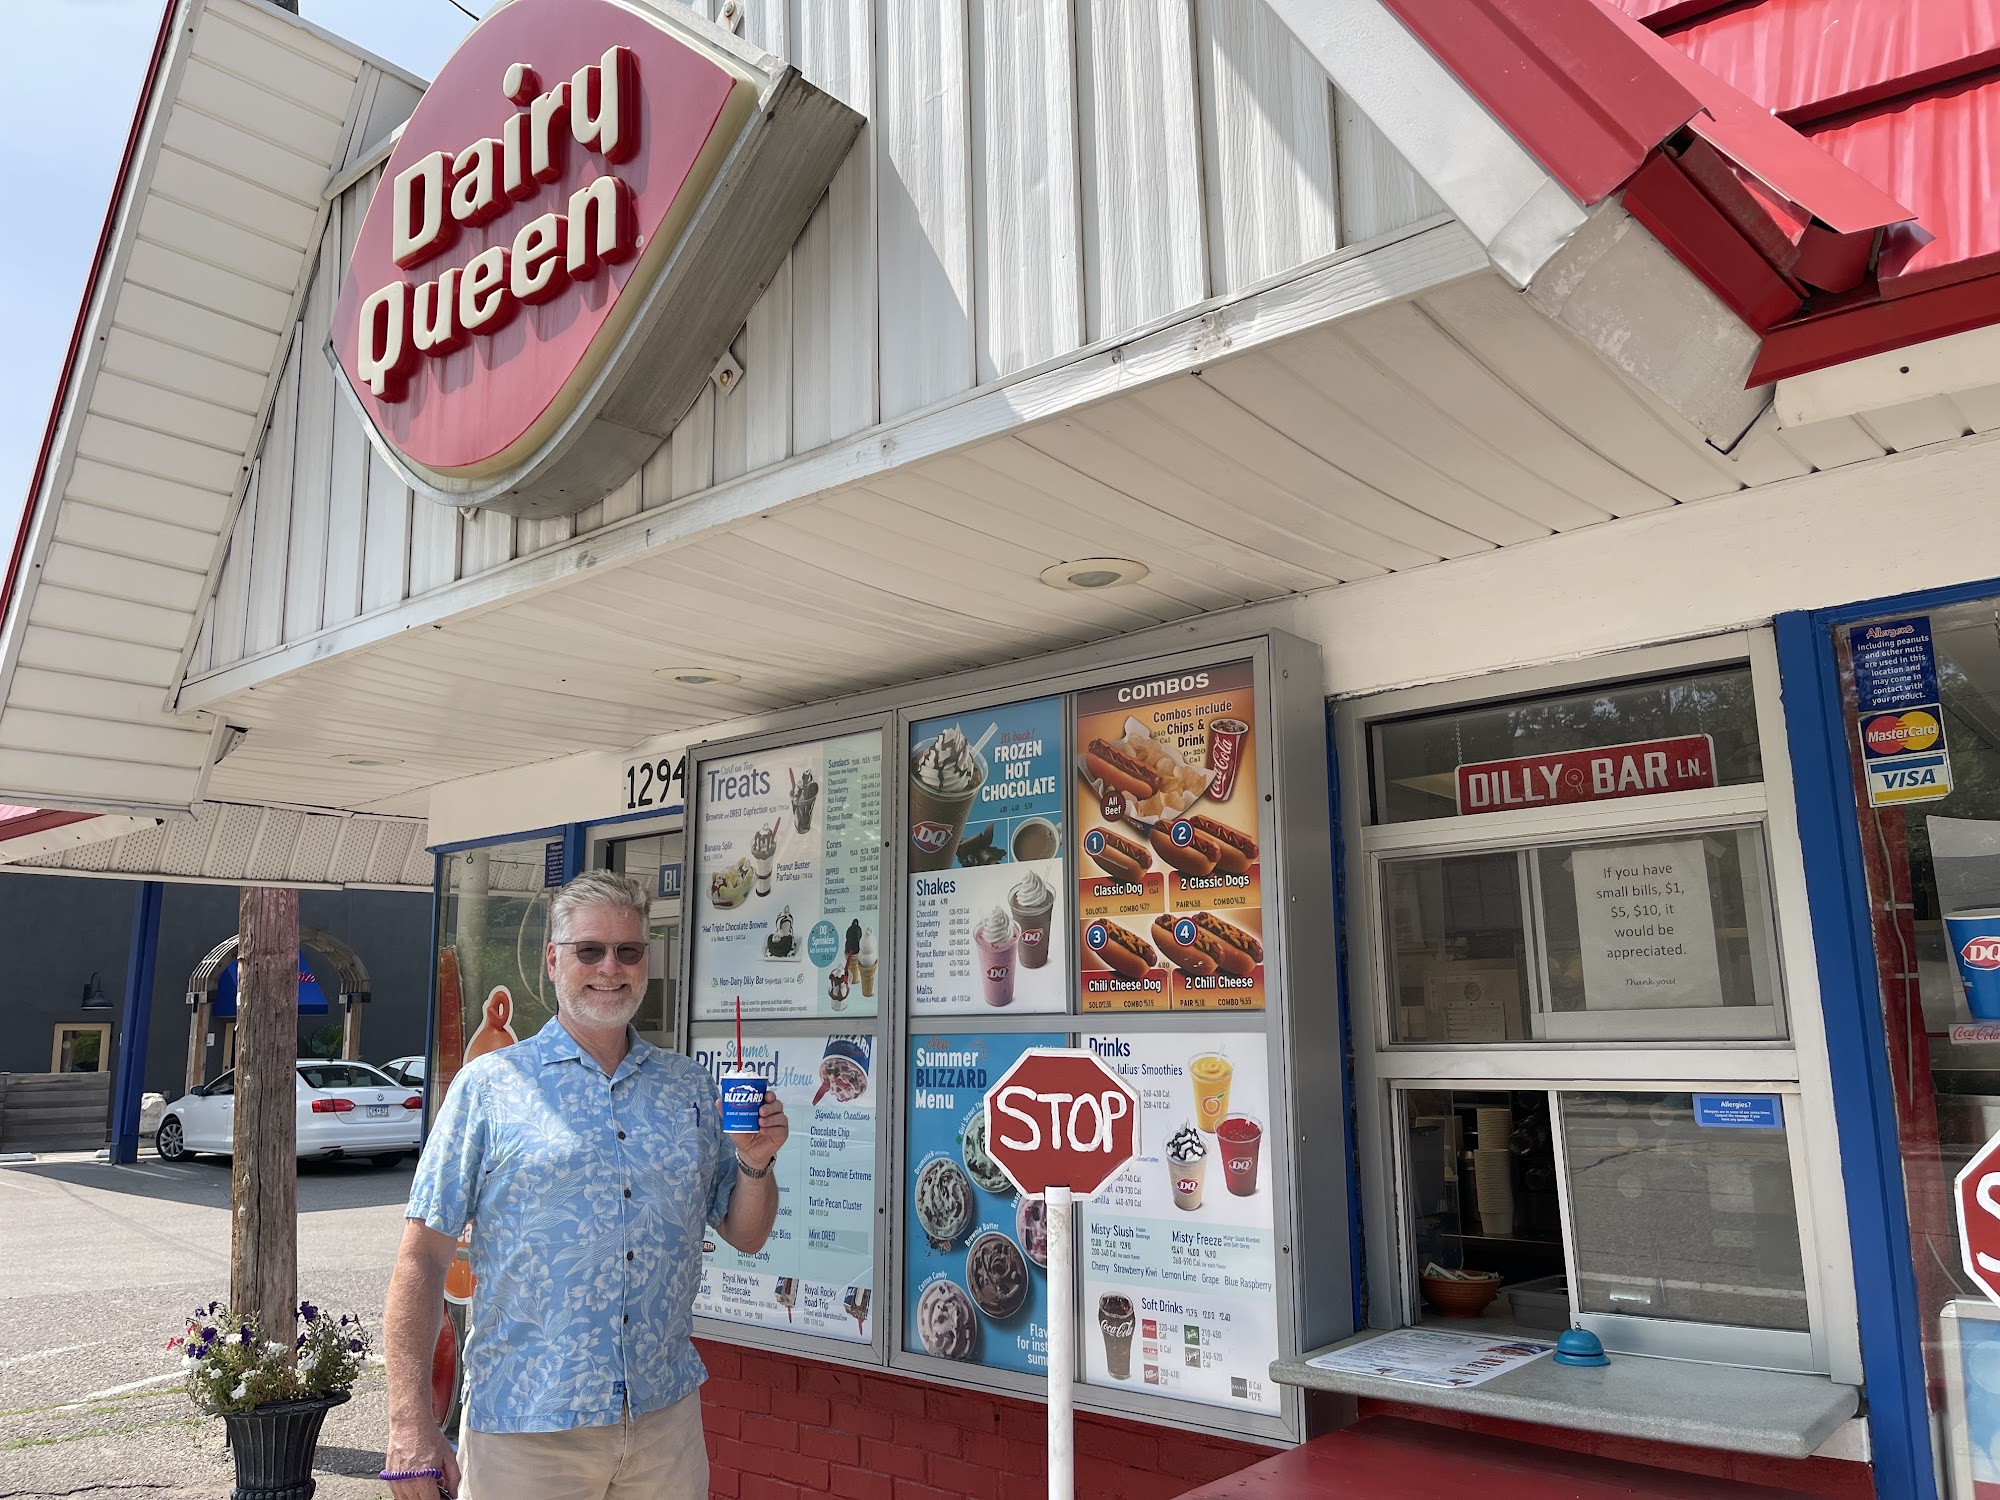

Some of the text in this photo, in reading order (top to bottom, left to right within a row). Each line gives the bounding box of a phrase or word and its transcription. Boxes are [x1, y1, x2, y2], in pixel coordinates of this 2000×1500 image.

[393, 45, 632, 268] Dairy
[358, 176, 632, 401] Queen
[1866, 625, 1914, 639] Allergens
[1857, 635, 1929, 651] including peanuts
[1865, 645, 1923, 659] and other nuts
[1879, 657, 1898, 667] used
[1871, 663, 1921, 676] location and
[1117, 672, 1210, 703] COMBOS
[1872, 677, 1889, 686] may
[1890, 675, 1912, 683] come
[1873, 682, 1923, 695] contact with
[1872, 692, 1926, 706] your product.
[1153, 700, 1232, 723] Combos include
[1167, 719, 1205, 735] Chips &
[1868, 723, 1937, 743] MasterCard
[1177, 733, 1205, 748] Drink
[994, 740, 1042, 763] FROZEN
[828, 759, 850, 769] Sundaes
[1005, 760, 1031, 780] HOT
[627, 755, 685, 809] 1294
[707, 768, 771, 803] Treats
[1468, 751, 1707, 809] DILLY BAR LN.
[1882, 768, 1936, 789] VISA
[981, 776, 1056, 803] CHOCOLATE
[1108, 796, 1118, 806] All
[1105, 805, 1122, 816] Beef
[918, 825, 948, 847] DQ
[1178, 826, 1187, 840] 2
[704, 841, 733, 853] Banana Split
[826, 840, 842, 849] Cones
[1091, 837, 1098, 850] 1
[776, 860, 811, 871] Peanut Buster
[1603, 864, 1673, 880] If you have
[916, 877, 956, 896] Shakes
[1180, 874, 1250, 890] 2 Classic Dogs
[1093, 882, 1143, 897] Classic Dog
[1596, 881, 1685, 899] small bills, $1,
[916, 909, 939, 918] Chocolate
[1610, 903, 1675, 919] $5, $10, it
[725, 922, 748, 931] Chocolate
[749, 920, 768, 930] Brownie
[916, 920, 940, 928] Strawberry
[1615, 924, 1674, 937] would be
[924, 930, 939, 939] Fudge
[1024, 932, 1042, 942] DQ
[1093, 930, 1101, 944] 3
[1180, 925, 1190, 938] 4
[916, 949, 947, 958] Peanut Butter
[1607, 943, 1687, 960] appreciated.
[1969, 943, 2000, 961] DQ
[916, 960, 934, 968] Banana
[755, 975, 764, 985] Bar
[916, 970, 935, 978] Caramel
[989, 968, 1008, 978] DQ
[1088, 978, 1161, 993] Chili Cheese Dog
[1185, 976, 1253, 989] 2 Chili Cheese
[1625, 978, 1676, 987] Thank you!
[916, 985, 933, 995] Malts
[926, 1036, 951, 1050] New
[1089, 1037, 1131, 1058] Drinks
[916, 1048, 979, 1068] Summer
[777, 1066, 814, 1087] Menu
[1141, 1064, 1183, 1076] Smoothies
[915, 1068, 987, 1089] BLIZZARD
[724, 1092, 764, 1103] BLIZZARD
[915, 1089, 954, 1110] Menu
[1720, 1101, 1751, 1109] Allergies?
[814, 1109, 842, 1122] Signature
[958, 1107, 976, 1136] Girl Scout
[996, 1085, 1128, 1154] STOP
[810, 1125, 850, 1139] Chocolate Chip
[810, 1137, 846, 1151] Cookie Dough
[913, 1150, 936, 1176] Drumstick
[1231, 1160, 1250, 1171] DQ
[809, 1166, 872, 1181] Choco Brownie Extreme
[1180, 1181, 1196, 1191] DQ
[808, 1196, 863, 1210] Turtle Pecan Cluster
[808, 1229, 821, 1240] Mint
[964, 1222, 1000, 1247] Brownie Batter
[1091, 1222, 1111, 1238] Misty
[1113, 1224, 1134, 1238] Slush
[1172, 1230, 1194, 1247] Misty
[1196, 1232, 1222, 1247] Freeze
[722, 1272, 760, 1287] Royal New York
[917, 1270, 948, 1293] Cotton Candy
[1091, 1260, 1272, 1292] Cherry Strawberry Kiwi Lemon Lime Grape Blue Raspberry
[722, 1284, 751, 1297] Cheesecake
[804, 1284, 837, 1300] Royal Rocky
[804, 1296, 829, 1310] Road Trip
[1141, 1297, 1184, 1315] Soft Drinks
